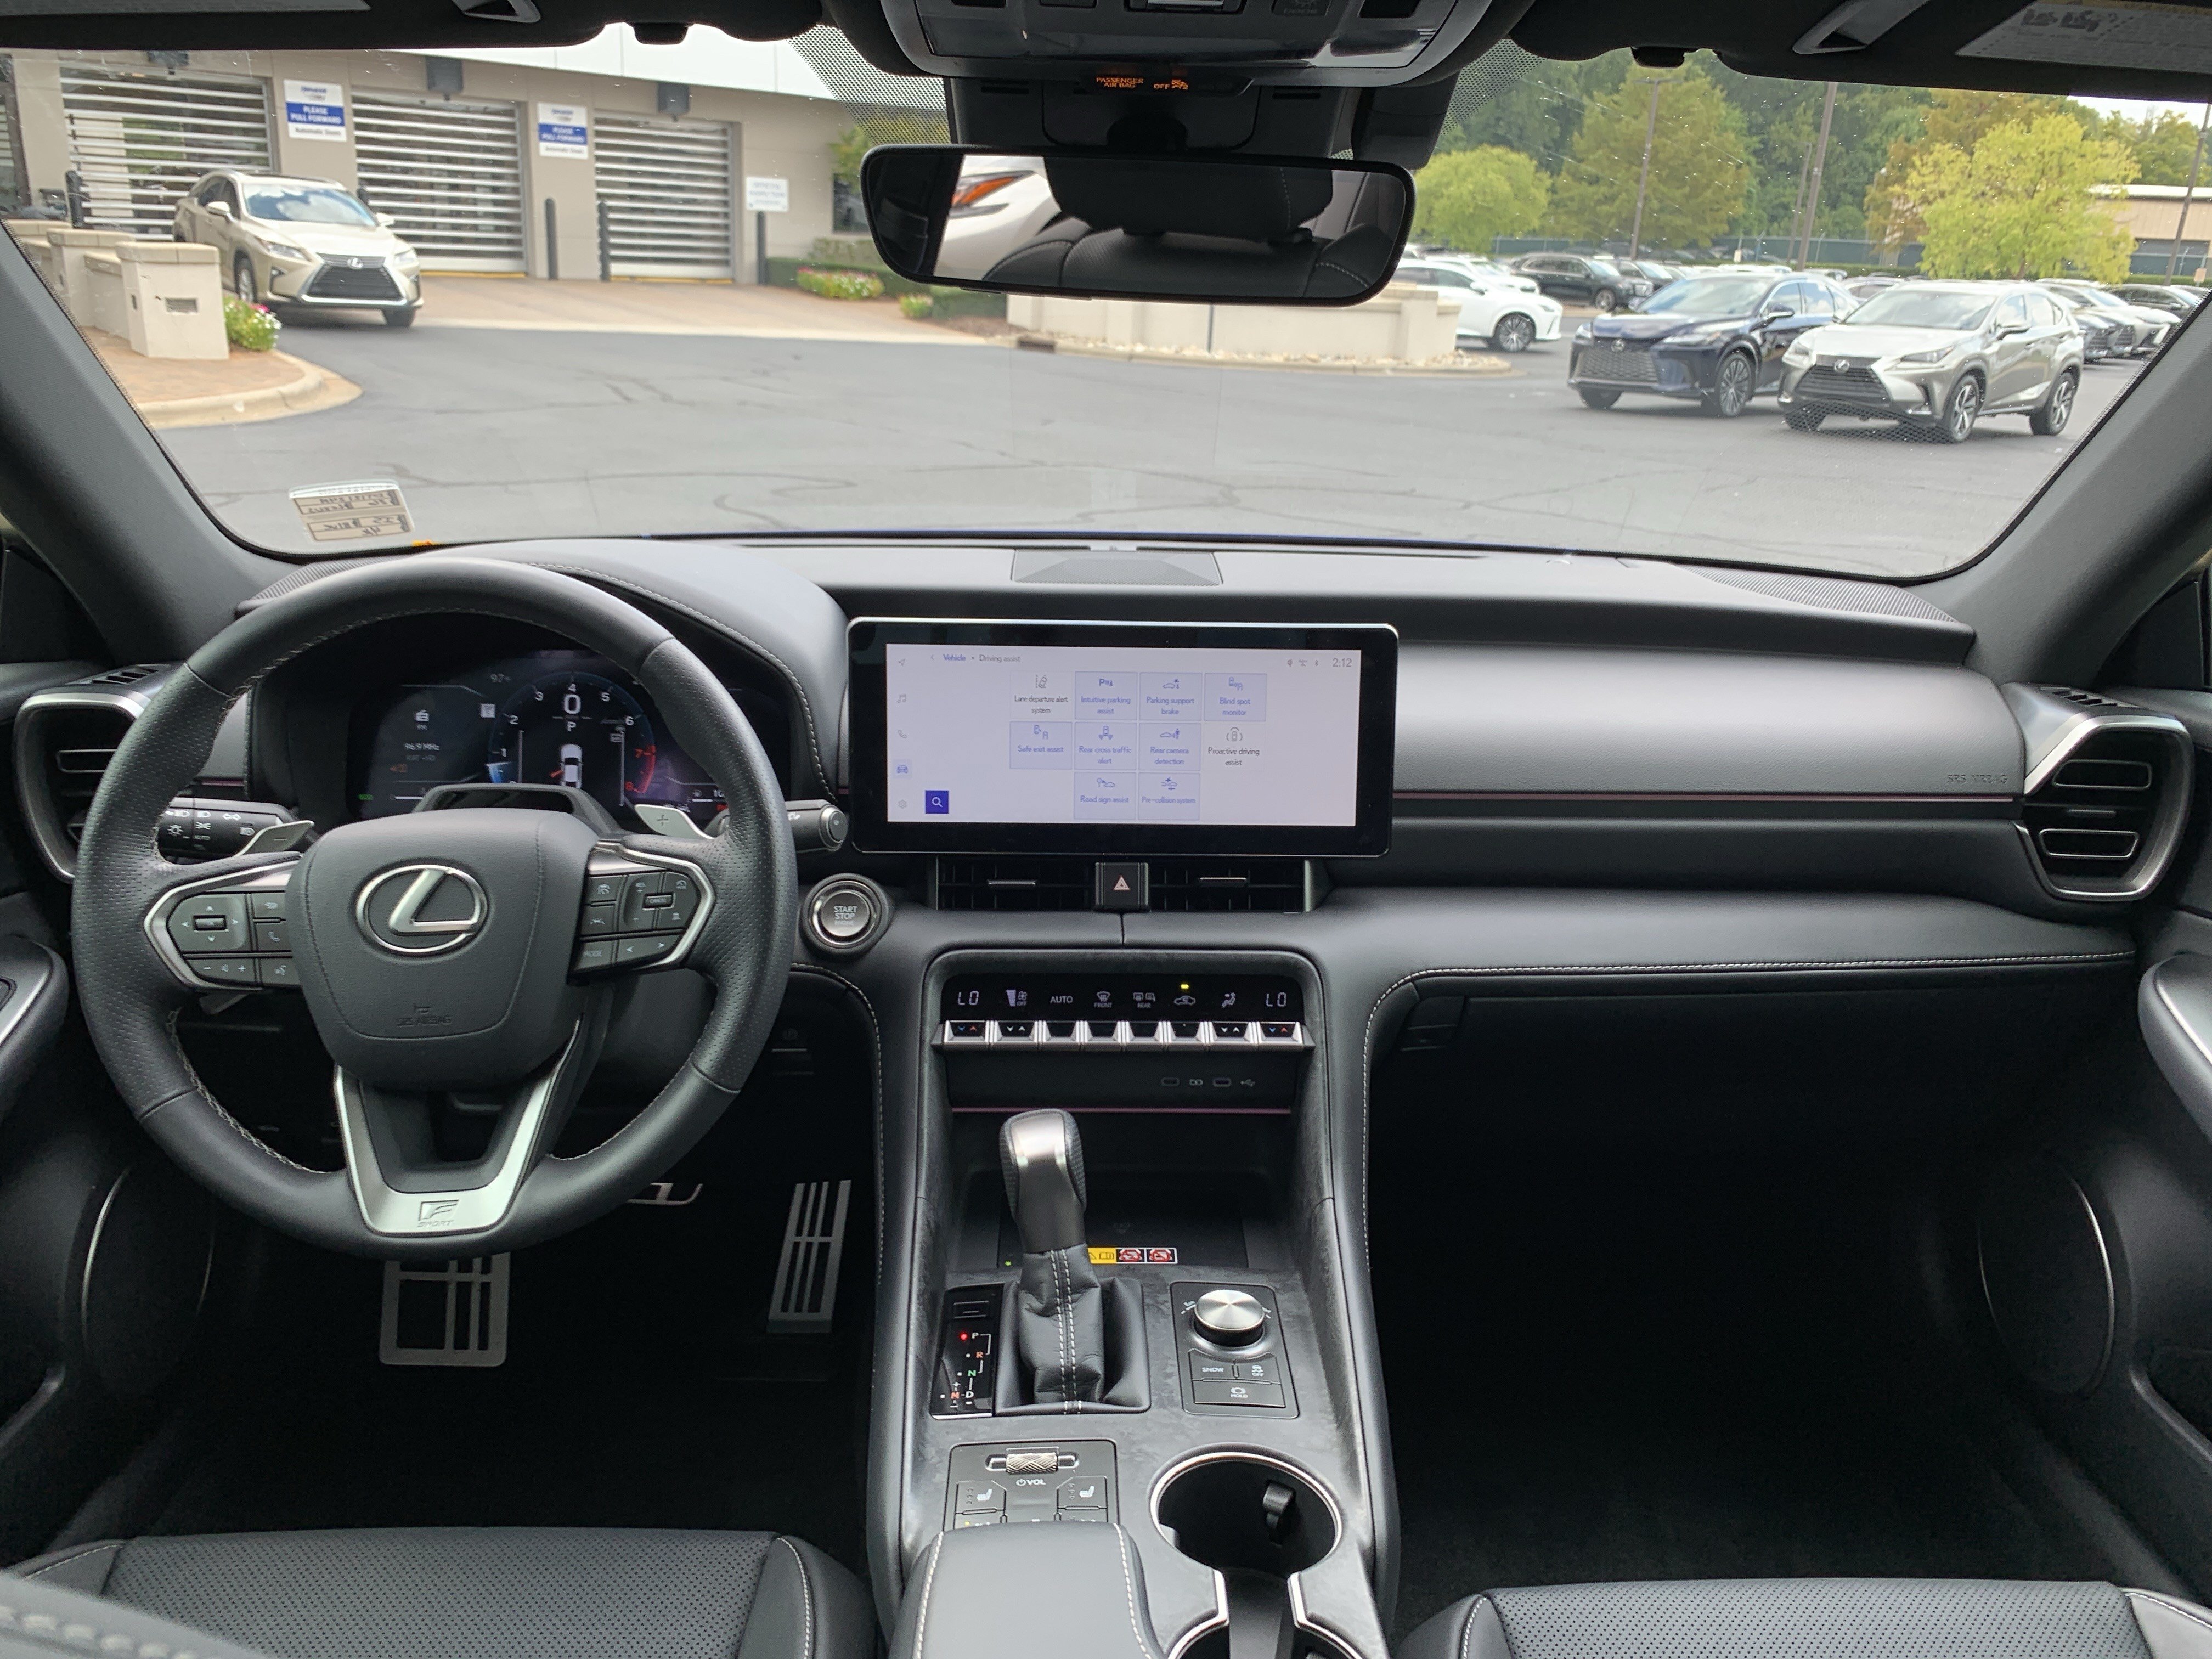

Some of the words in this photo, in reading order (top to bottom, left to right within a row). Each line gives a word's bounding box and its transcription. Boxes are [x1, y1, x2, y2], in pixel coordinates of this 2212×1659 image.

[979, 654, 1002, 663] Driving
[1332, 658, 1352, 667] 2:12
[534, 691, 544, 701] 3
[601, 692, 610, 702] 5
[1107, 696, 1131, 704] parking
[1147, 696, 1170, 705] Parking
[564, 694, 581, 714] 0
[509, 715, 518, 725] 2
[625, 716, 634, 725] 6
[567, 721, 576, 732] P
[501, 748, 507, 757] 1
[635, 749, 643, 758] 7
[1238, 748, 1260, 756] driving
[1948, 774, 1966, 783] SRS
[625, 781, 634, 790] 8
[1142, 795, 1176, 804] Pre-collision
[957, 991, 979, 1006] LO
[1050, 995, 1074, 1004] AUTO
[1266, 992, 1286, 1007] LO
